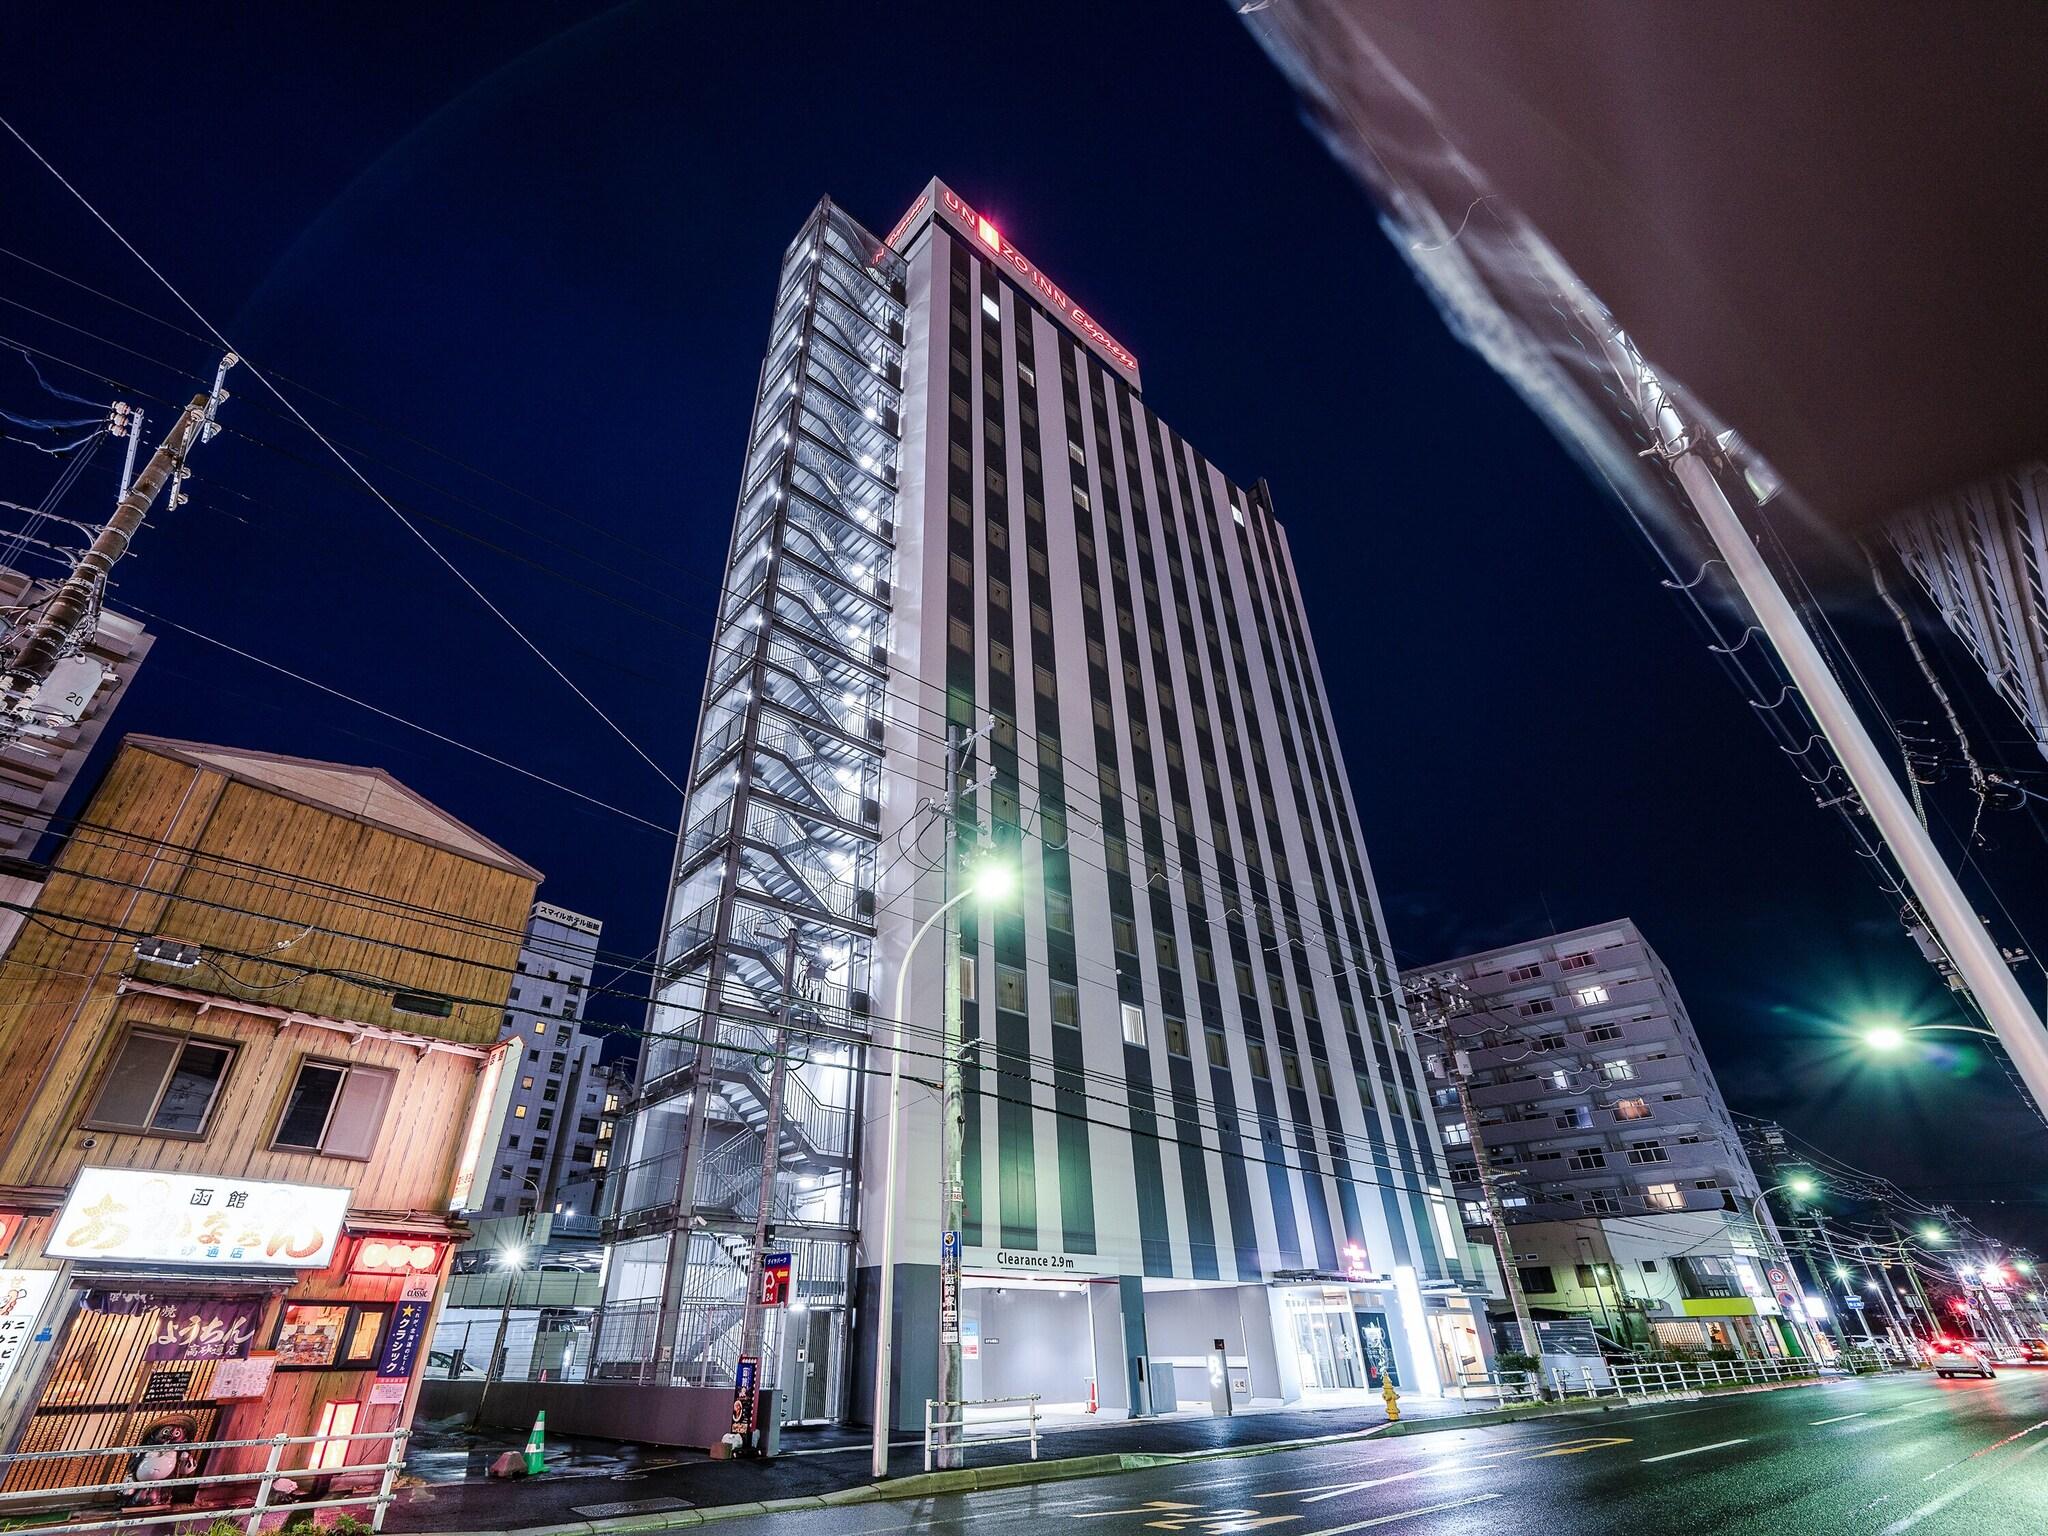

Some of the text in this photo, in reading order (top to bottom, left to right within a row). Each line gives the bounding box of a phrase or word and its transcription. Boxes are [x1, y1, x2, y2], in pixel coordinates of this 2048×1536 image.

[1031, 271, 1066, 311] INN
[65, 691, 84, 707] 20
[190, 1188, 249, 1209] 函館
[997, 1252, 1048, 1267] Clearance
[406, 1288, 428, 1298] CLASSIC
[386, 1318, 410, 1373] クラシック
